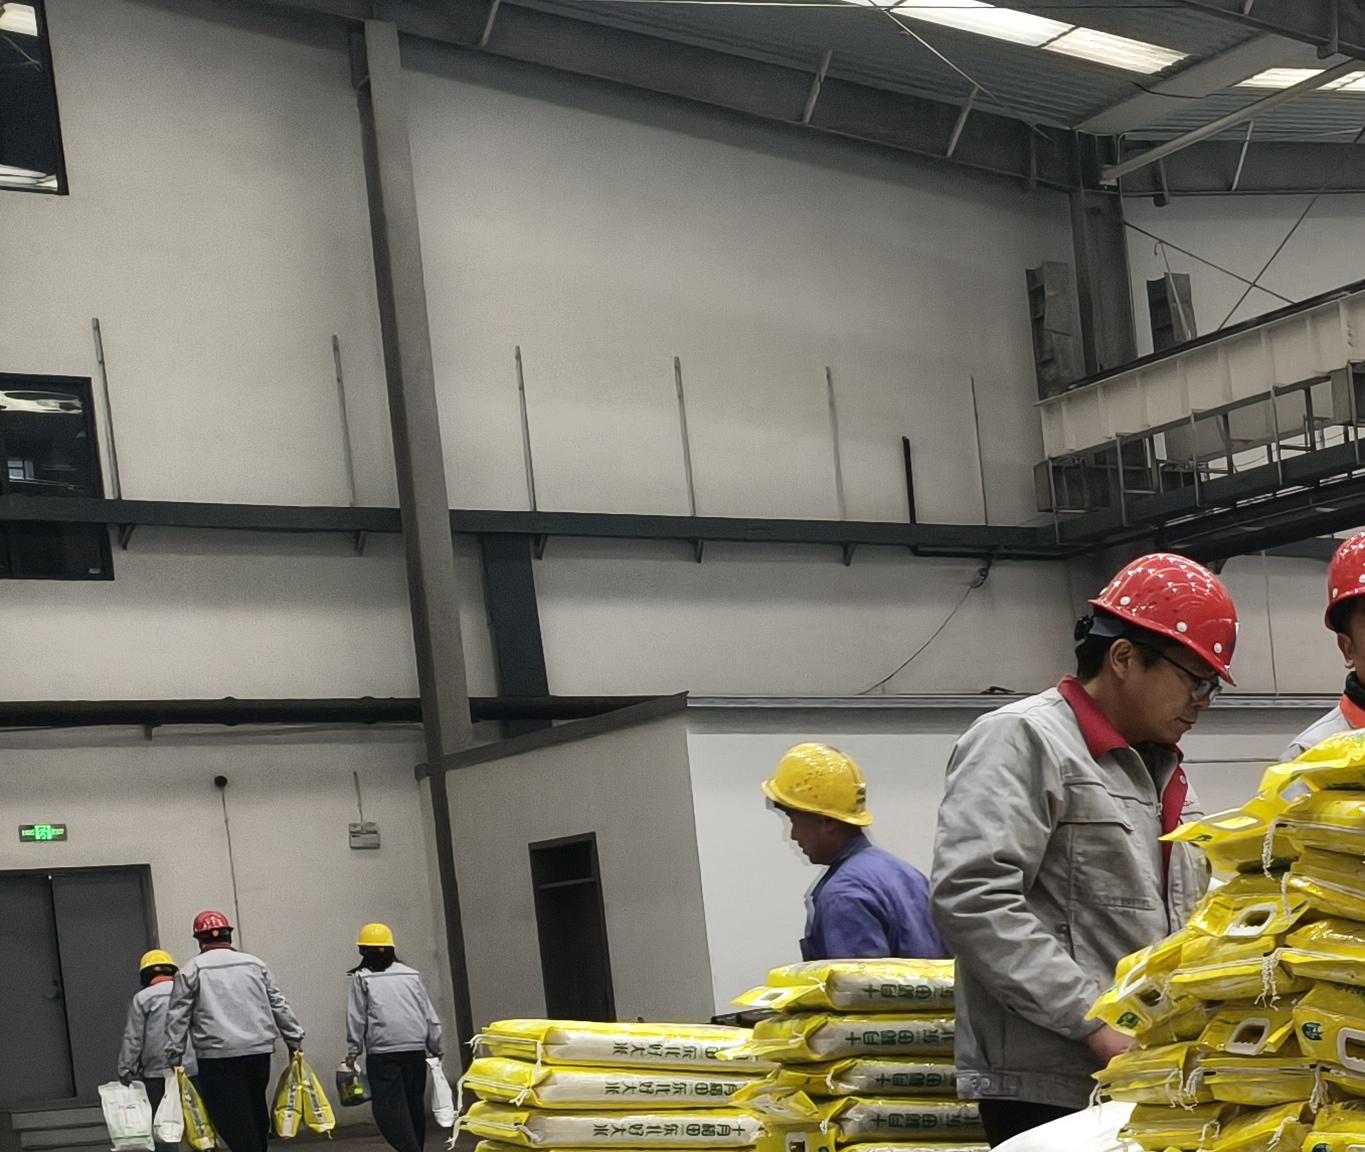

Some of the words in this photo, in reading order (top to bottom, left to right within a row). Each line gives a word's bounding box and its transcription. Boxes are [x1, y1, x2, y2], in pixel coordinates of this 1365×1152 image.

[613, 1041, 697, 1060] 东北好大米
[605, 1081, 687, 1095] 东北好大米
[695, 1081, 745, 1096] 月稻田
[593, 1123, 678, 1137] 东北好大米
[685, 1123, 745, 1137] 十月稻田
